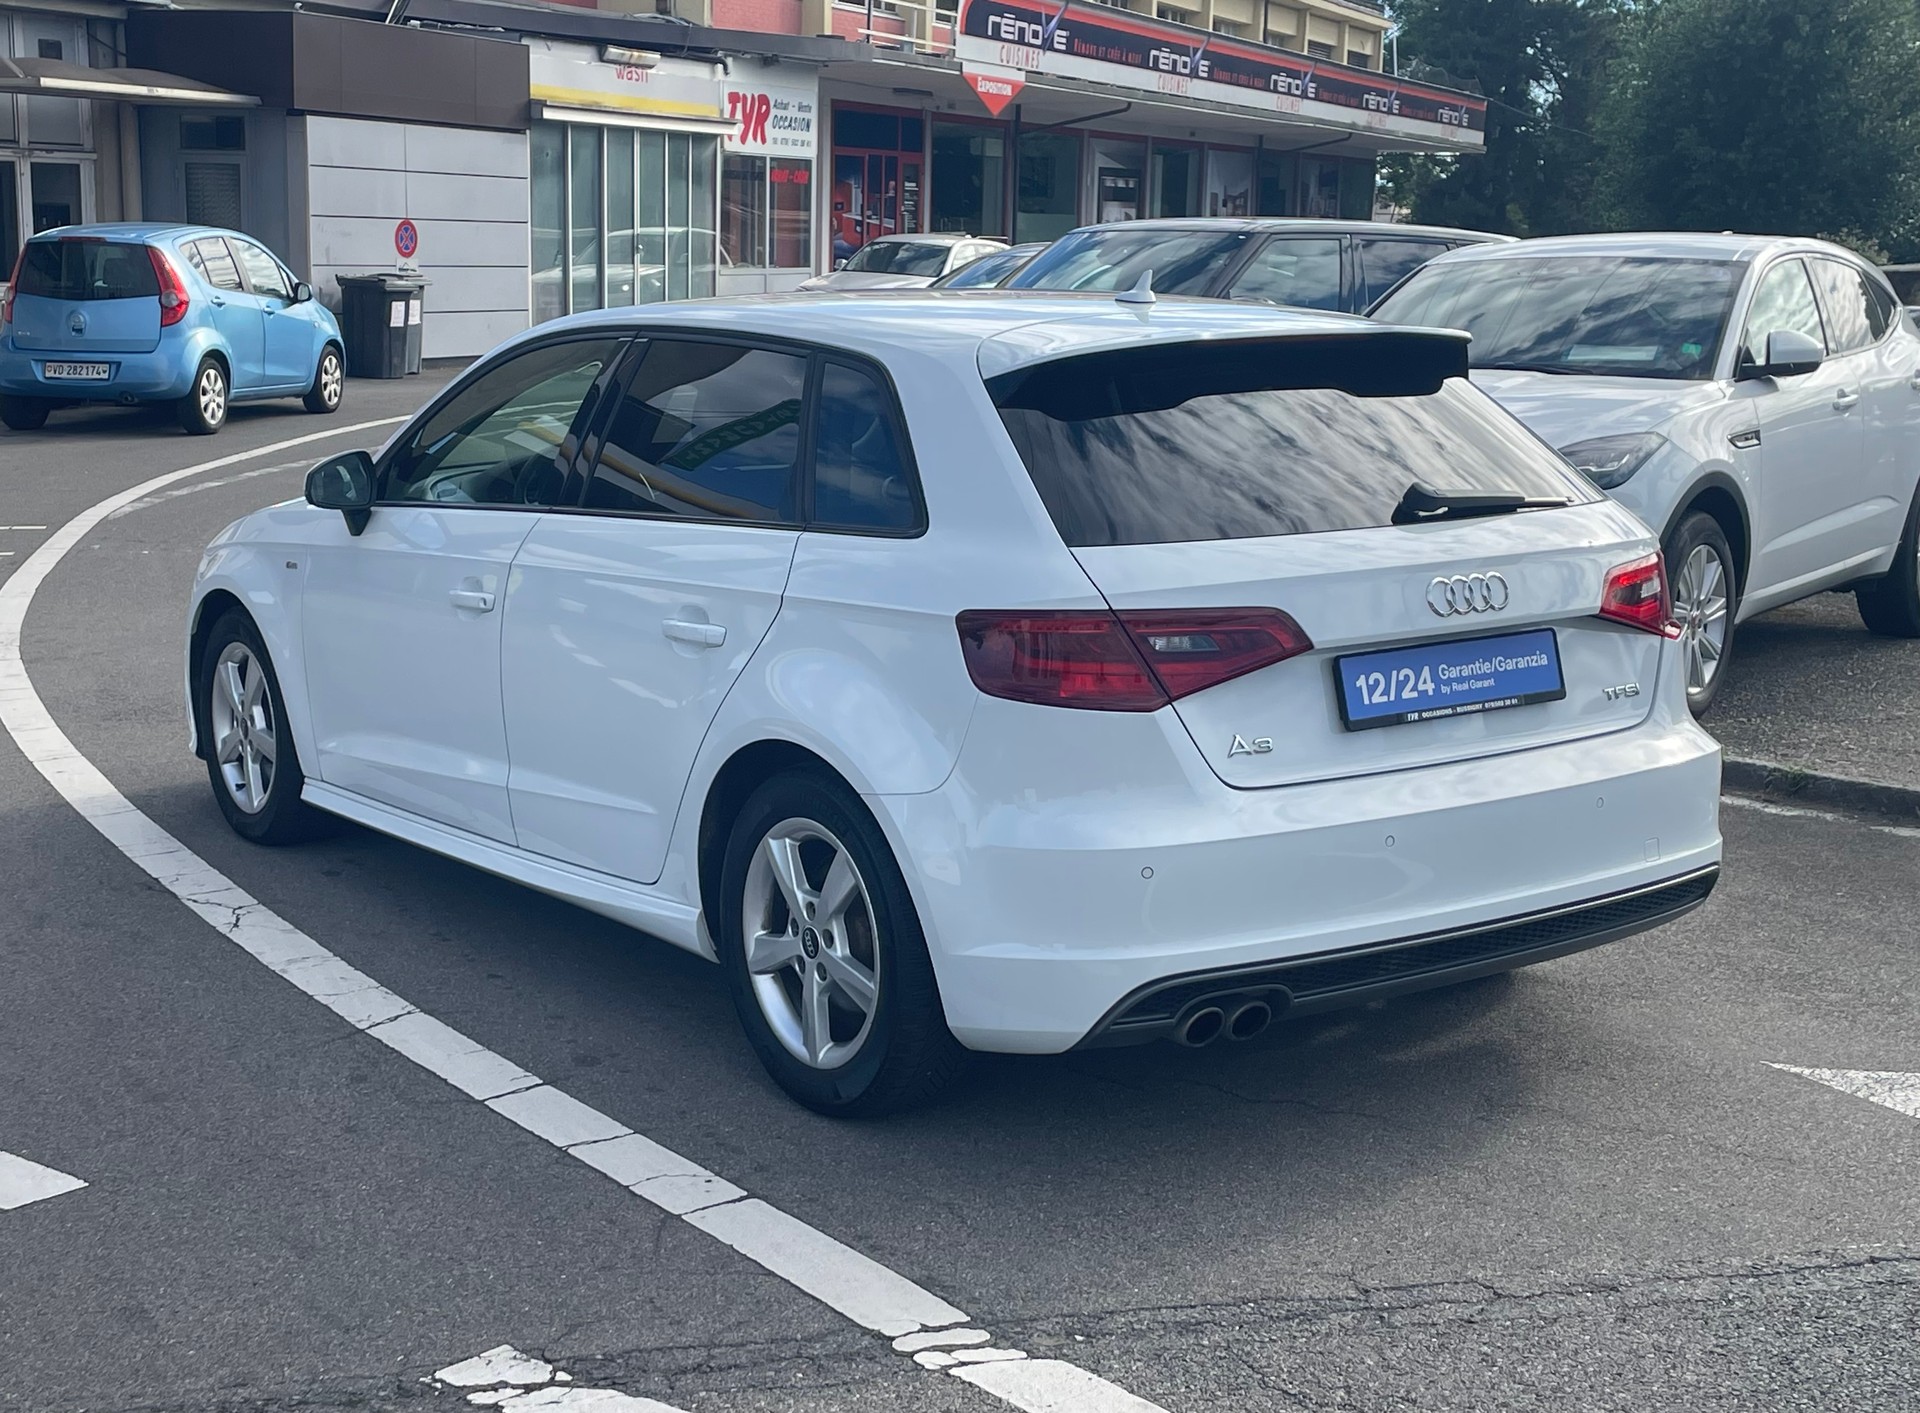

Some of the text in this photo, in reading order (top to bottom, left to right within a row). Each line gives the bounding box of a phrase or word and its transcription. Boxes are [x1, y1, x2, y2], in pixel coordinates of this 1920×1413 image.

[1000, 44, 1040, 69] CUISINES
[727, 92, 771, 145] TYR
[772, 114, 811, 132] OCCASION
[53, 365, 64, 375] VD
[1356, 650, 1548, 705] 12/24 Garantie/Garanzia
[1441, 678, 1495, 694] by Real Garant
[1602, 683, 1640, 701] TFSI
[1228, 734, 1273, 758] A3
